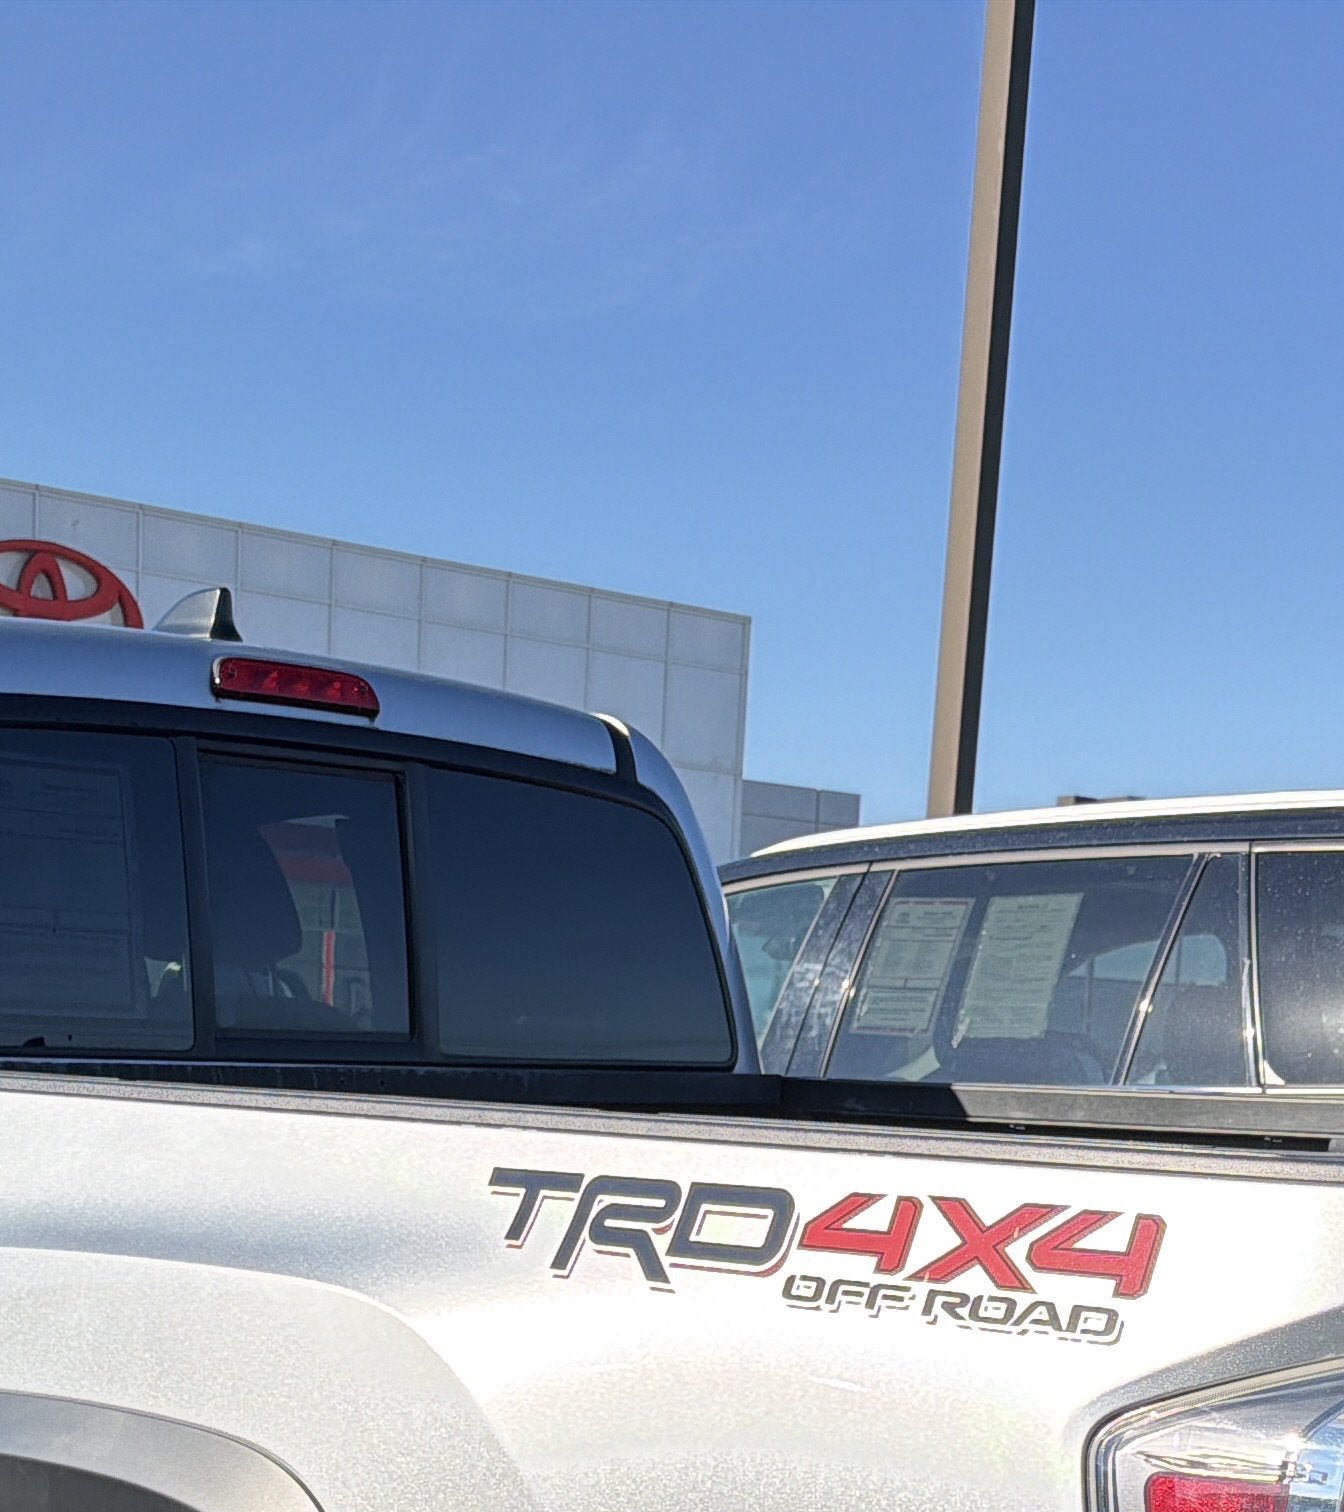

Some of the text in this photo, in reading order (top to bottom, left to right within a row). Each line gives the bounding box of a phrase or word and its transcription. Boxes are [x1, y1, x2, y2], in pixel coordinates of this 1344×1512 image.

[488, 1167, 800, 1290] TRD
[782, 1274, 1123, 1344] OFF ROAD
